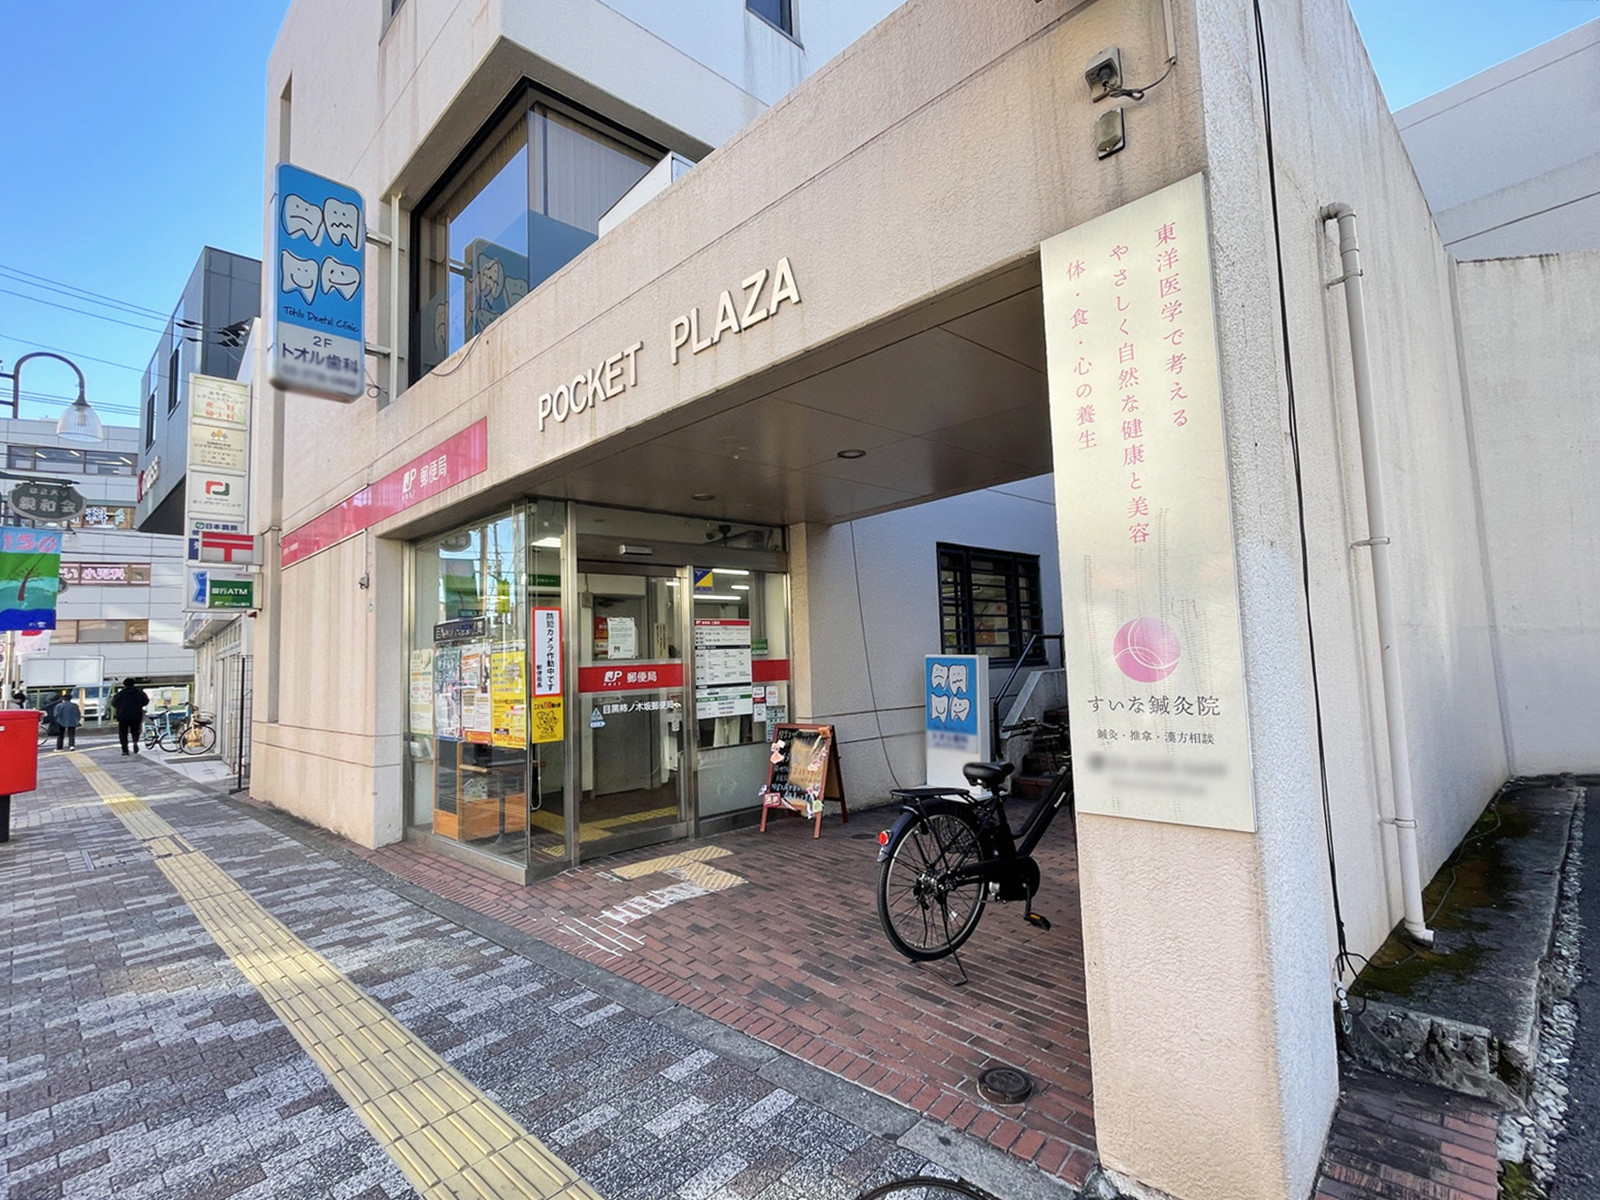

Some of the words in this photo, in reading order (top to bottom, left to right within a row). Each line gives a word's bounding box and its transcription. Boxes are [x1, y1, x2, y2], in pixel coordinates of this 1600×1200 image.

[307, 311, 333, 326] Dental
[336, 320, 359, 333] Clinic
[1155, 221, 1189, 427] 東洋医学で考える
[313, 336, 332, 348] 2F
[538, 341, 643, 432] POCKET
[670, 256, 801, 365] PLAZA
[282, 343, 358, 375] トオル歯科
[1066, 259, 1097, 450] 体・食・心の養生
[1110, 244, 1150, 544] やさしく自然な健康と美容
[420, 454, 447, 488] 郵便局
[19, 496, 77, 514] 親和会
[4, 534, 57, 553] 150
[82, 567, 126, 580] 小児科
[211, 587, 248, 595] 銀行ATM
[604, 671, 622, 683] JP
[627, 670, 657, 683] 郵便局
[1088, 694, 1221, 716] すいな鍼灸院
[1097, 729, 1215, 745] 鍼灸・推拿・漢方相談
